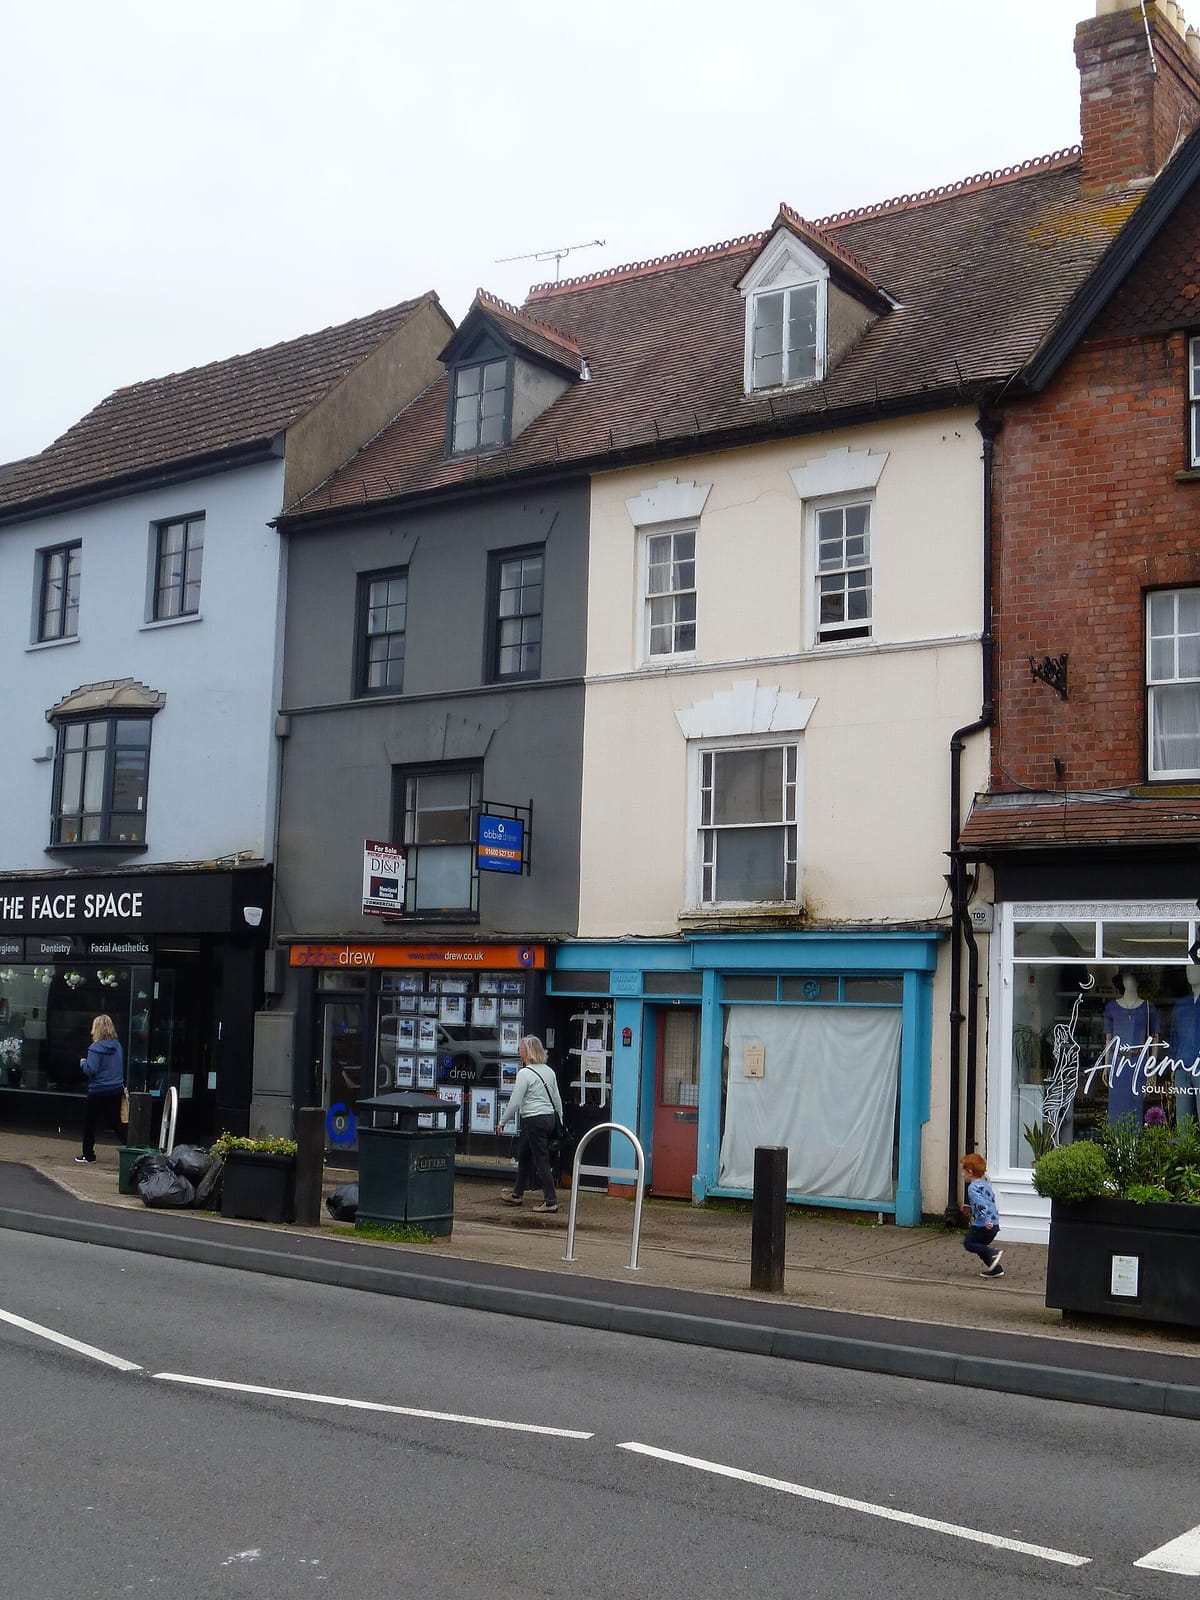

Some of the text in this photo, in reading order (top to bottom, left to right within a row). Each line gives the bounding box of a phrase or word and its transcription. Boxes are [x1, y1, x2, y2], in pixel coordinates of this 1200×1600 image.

[374, 844, 398, 854] For Sale
[371, 858, 400, 874] DJ&P
[31, 894, 76, 919] FACE
[83, 892, 143, 918] SPACE
[0, 944, 20, 954] giene
[40, 943, 71, 955] Dentistry
[90, 942, 149, 953] Facial Aesthetics
[1141, 1085, 1167, 1094] SOUL
